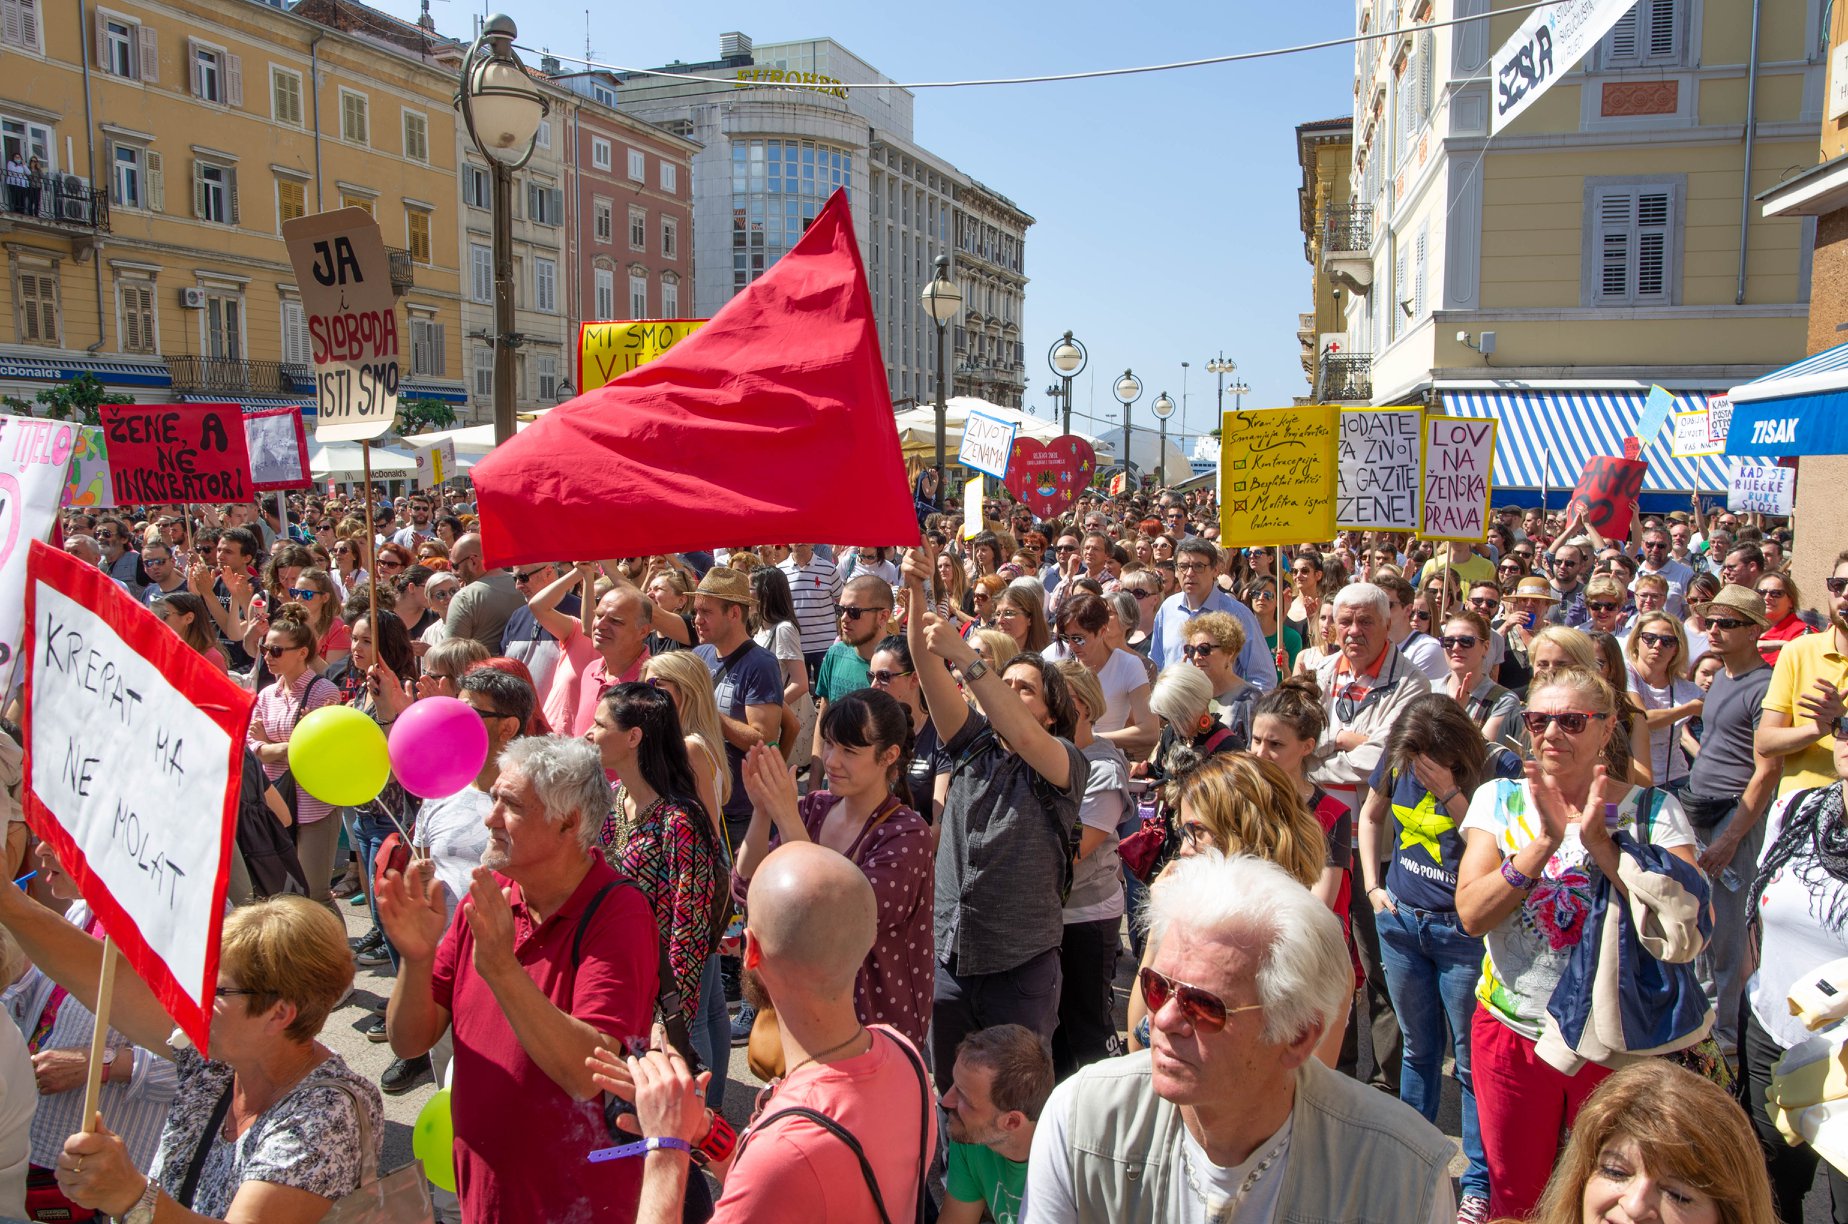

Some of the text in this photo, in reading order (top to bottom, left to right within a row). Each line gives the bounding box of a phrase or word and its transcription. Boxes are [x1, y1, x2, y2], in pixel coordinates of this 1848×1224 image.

[313, 236, 364, 287] JA
[308, 308, 399, 365] SLOBODA
[585, 324, 674, 351] MI SMO
[0, 366, 61, 378] cDonald's
[318, 361, 399, 418] ISTI SMO
[200, 413, 229, 452] A
[1433, 421, 1490, 447] LOV
[1751, 418, 1799, 444] TISAK
[370, 470, 407, 479] McDonald's
[1443, 447, 1475, 472] NA
[1740, 466, 1786, 481] KAD SE
[116, 467, 244, 503] INKUBATORI
[1425, 469, 1486, 504] ŽENSKA
[1336, 490, 1416, 527] ŽENE!
[1424, 505, 1481, 534] PRAVA
[46, 612, 143, 727] KREPAT
[63, 735, 100, 798] NE
[112, 797, 186, 910] MOLAT
[1420, 865, 1457, 885] POINTS
